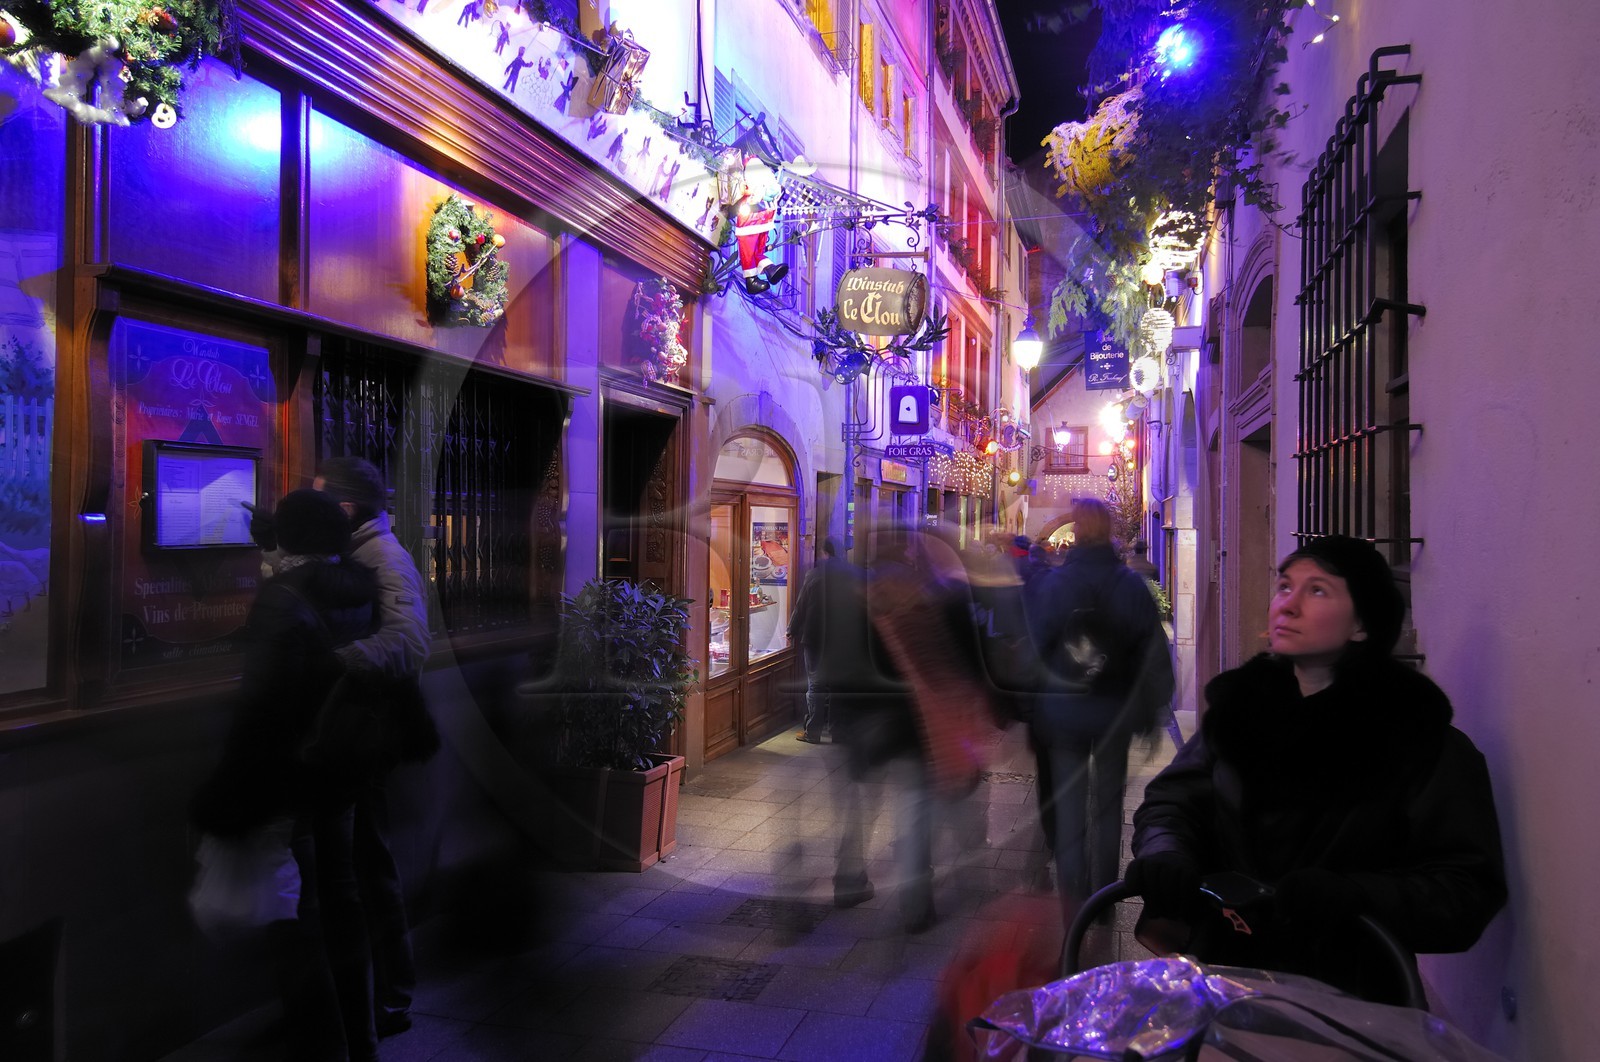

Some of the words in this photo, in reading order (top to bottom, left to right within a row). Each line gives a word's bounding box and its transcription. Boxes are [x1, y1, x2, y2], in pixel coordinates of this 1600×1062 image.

[847, 276, 904, 295] Winstub
[860, 292, 901, 326] Clou
[1090, 350, 1124, 361] Bijouterie
[1102, 343, 1112, 351] de
[197, 359, 232, 396] Clou
[187, 407, 204, 420] Marie
[216, 411, 232, 425] Roger
[888, 447, 908, 456] FOIE
[908, 446, 932, 456] GRAS
[143, 605, 170, 624] Vins
[174, 602, 187, 622] de
